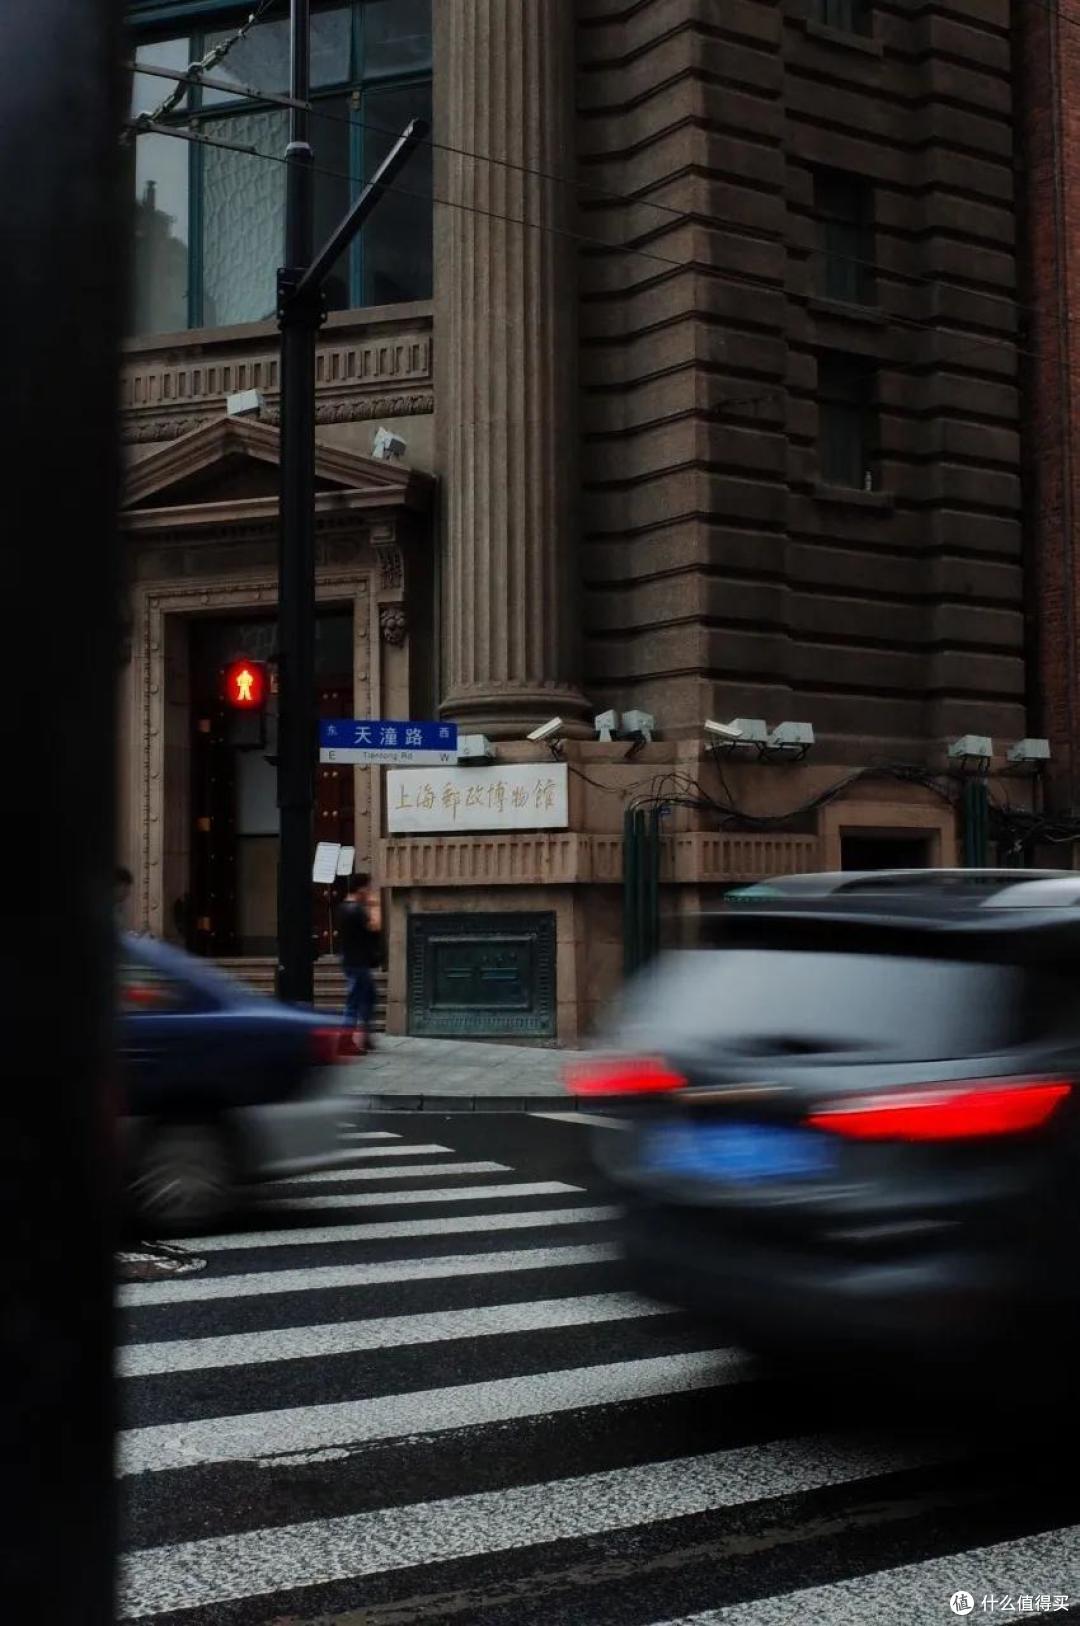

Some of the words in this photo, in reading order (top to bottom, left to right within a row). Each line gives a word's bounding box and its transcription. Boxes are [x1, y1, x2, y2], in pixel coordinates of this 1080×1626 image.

[327, 725, 338, 737] 东
[354, 726, 422, 745] 天潼路
[439, 727, 449, 738] 西
[328, 750, 336, 760] E
[440, 753, 449, 761] W
